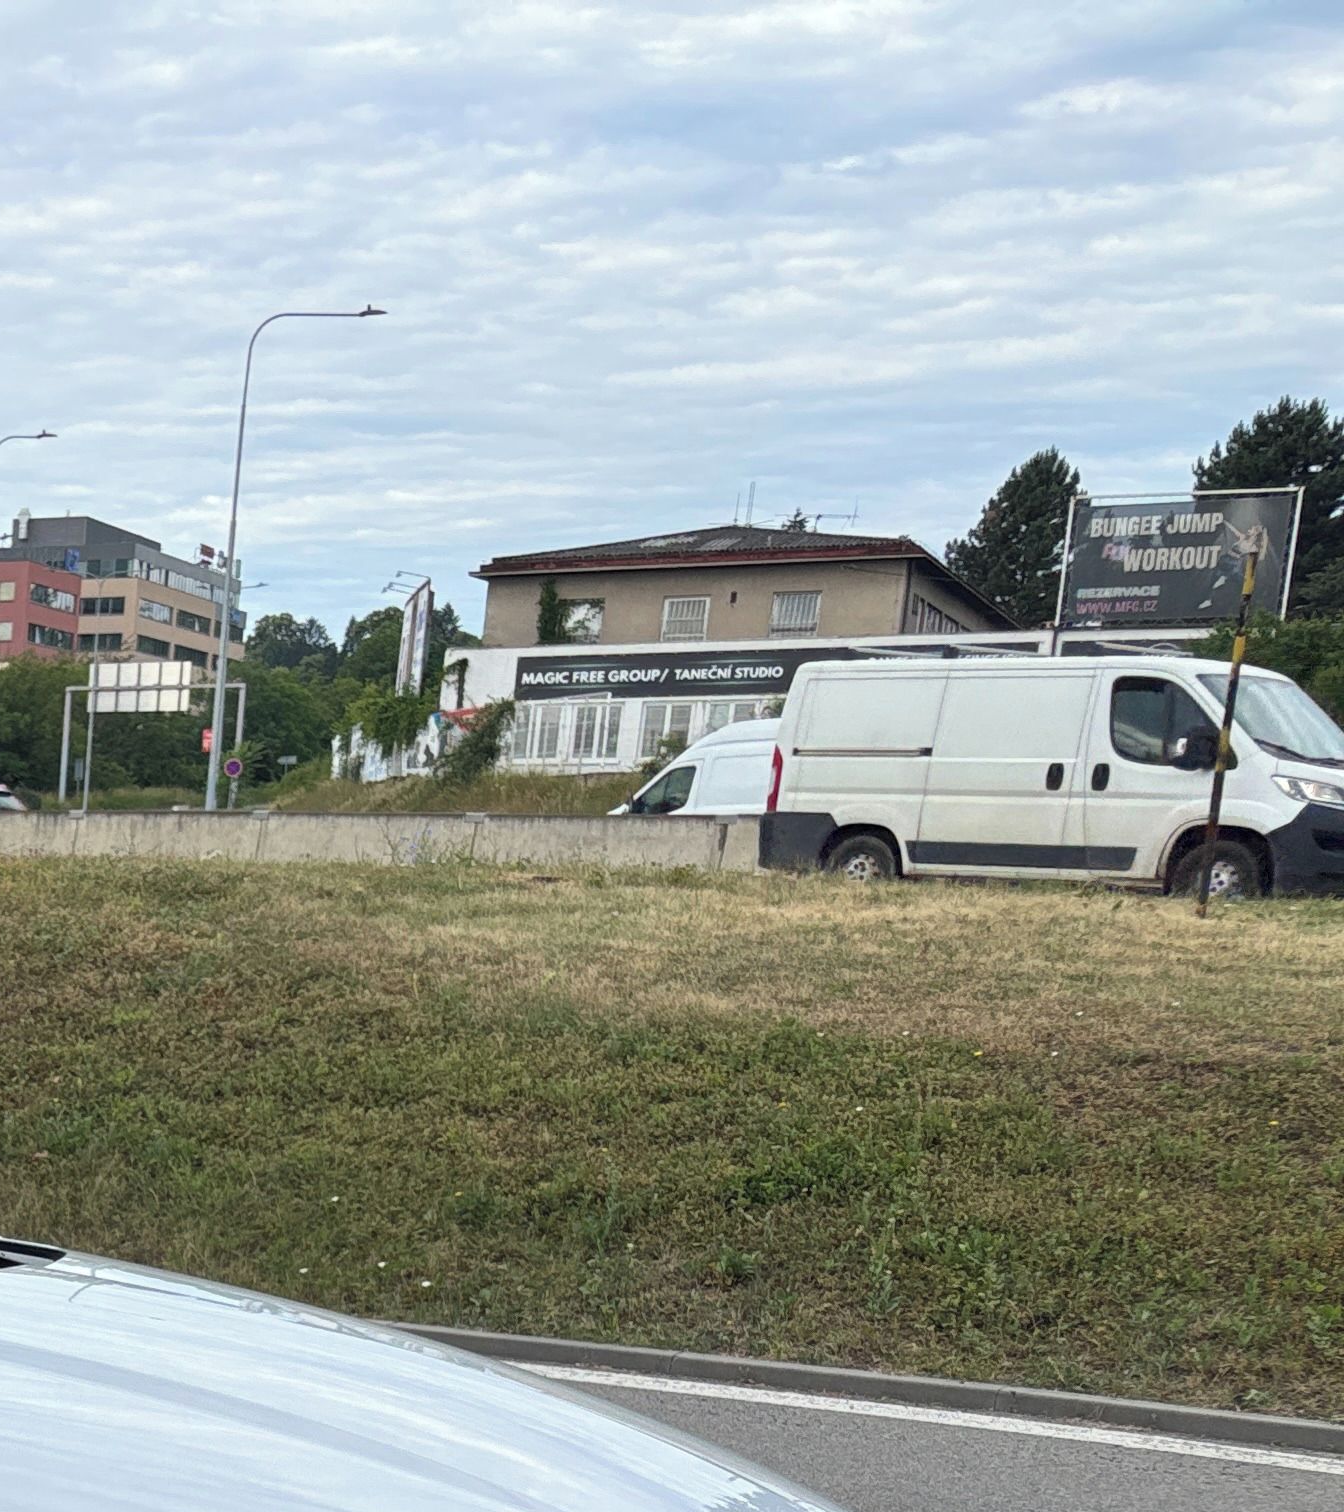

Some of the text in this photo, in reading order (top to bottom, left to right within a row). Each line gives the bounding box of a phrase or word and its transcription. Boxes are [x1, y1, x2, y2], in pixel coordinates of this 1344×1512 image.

[1090, 512, 1224, 538] BUNGEE JUMP
[1123, 545, 1222, 573] WORKOUT
[1077, 585, 1160, 599] REZERVACE
[521, 671, 569, 685] MAGIC
[572, 670, 605, 683] FREE
[674, 664, 733, 680] TANEČNÍ
[735, 665, 784, 679] STUDIO
